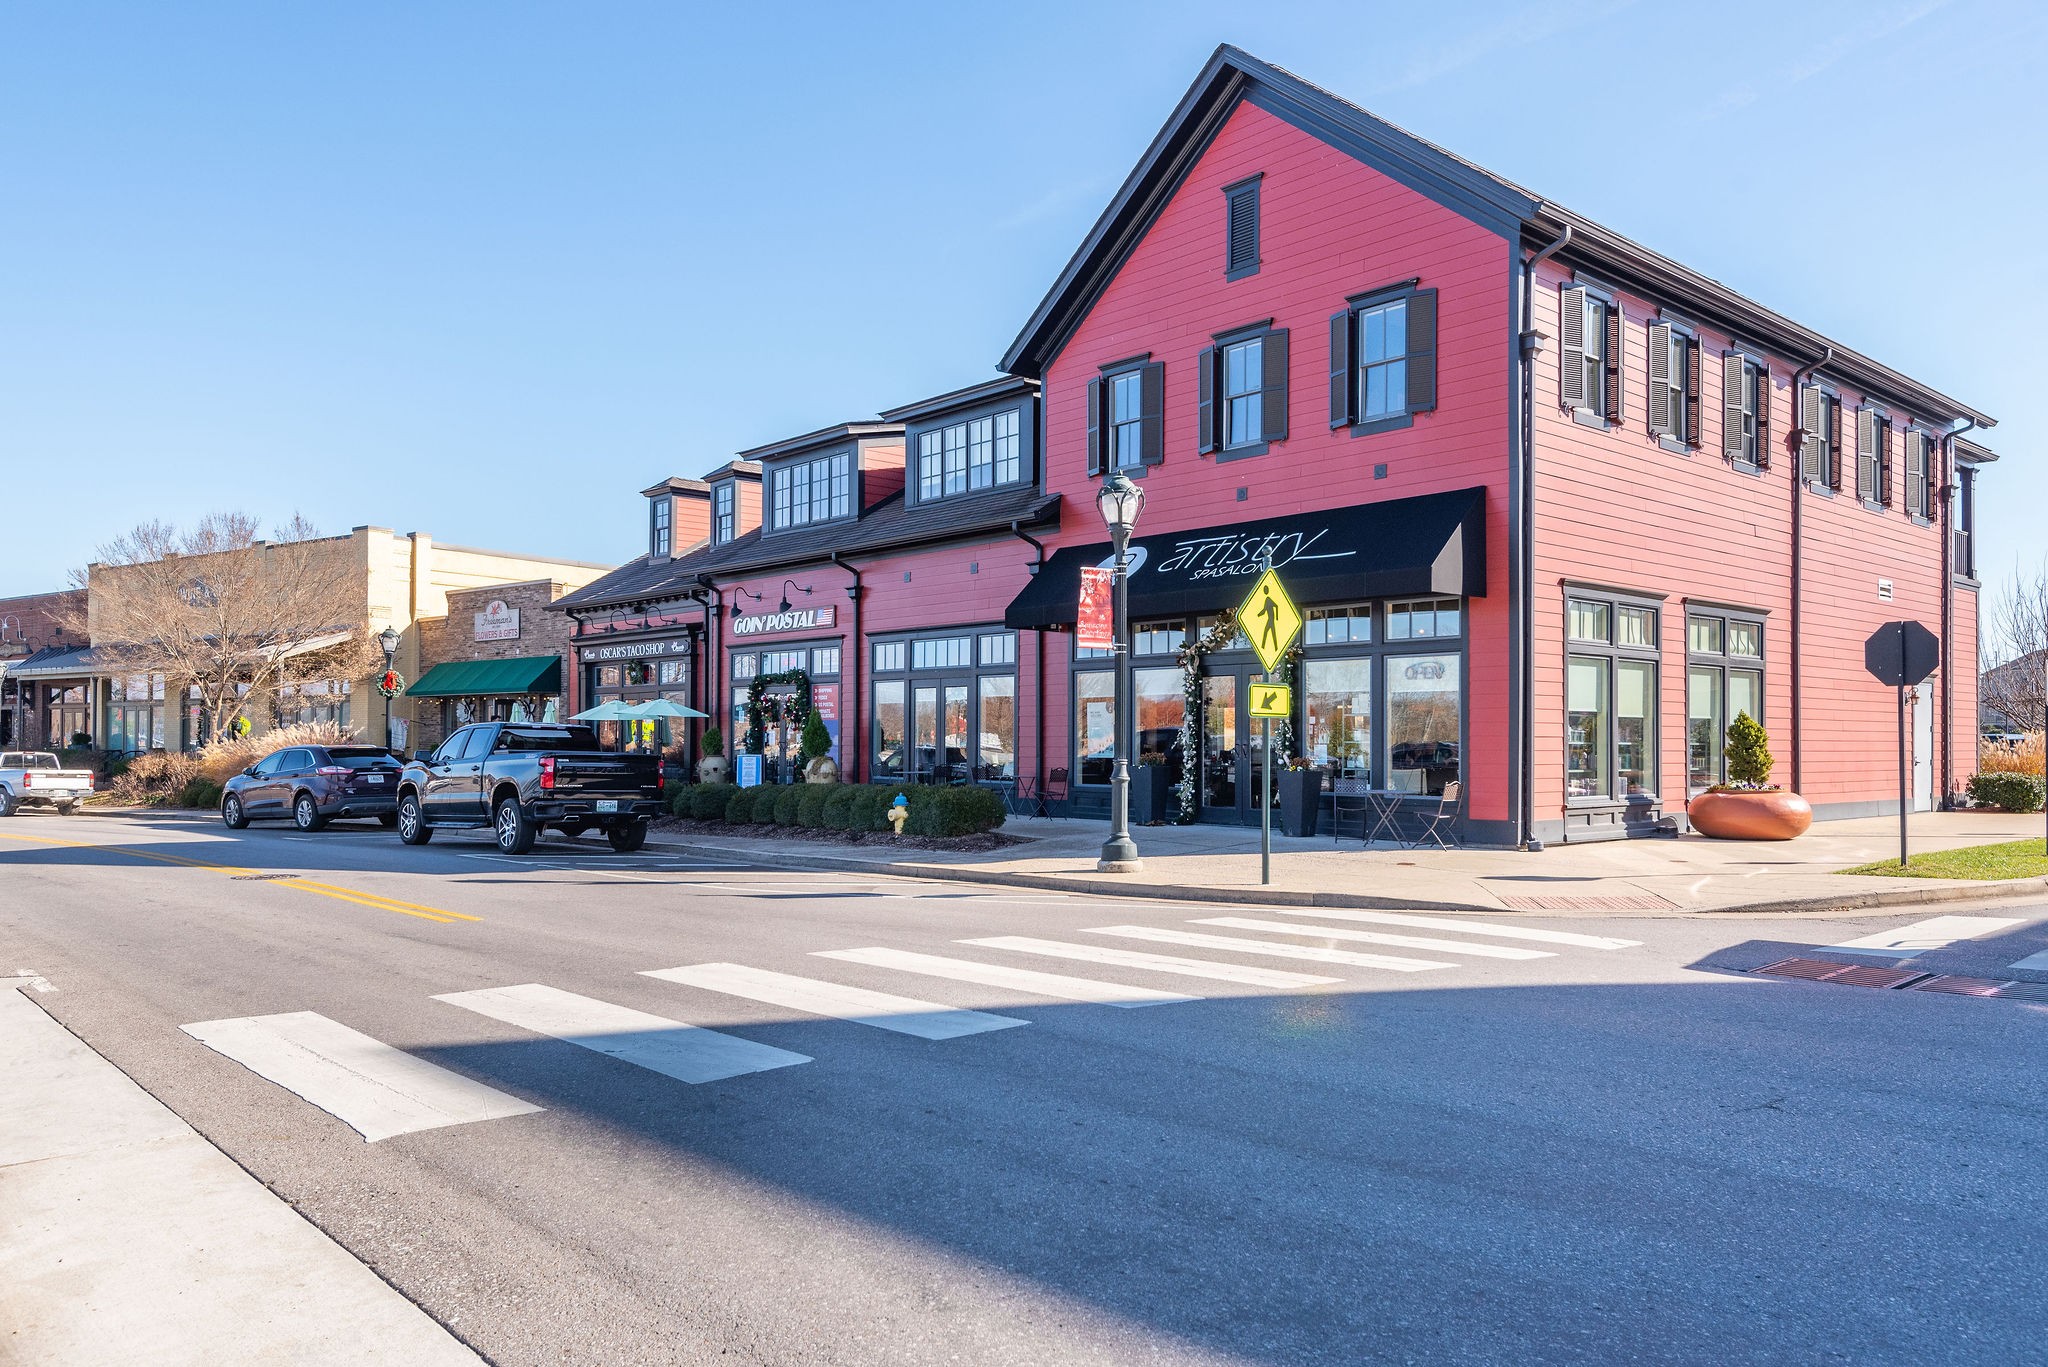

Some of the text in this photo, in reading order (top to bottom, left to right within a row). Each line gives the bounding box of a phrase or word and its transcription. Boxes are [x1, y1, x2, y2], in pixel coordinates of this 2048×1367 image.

[1158, 528, 1357, 573] artistry
[766, 610, 816, 631] POSTAL
[475, 631, 498, 639] FLOWERS
[503, 628, 518, 638] GIFTS
[600, 646, 627, 659] OSCAR'S
[627, 645, 645, 657] TACO
[645, 643, 665, 655] SHOP
[1405, 664, 1443, 680] OPEN
